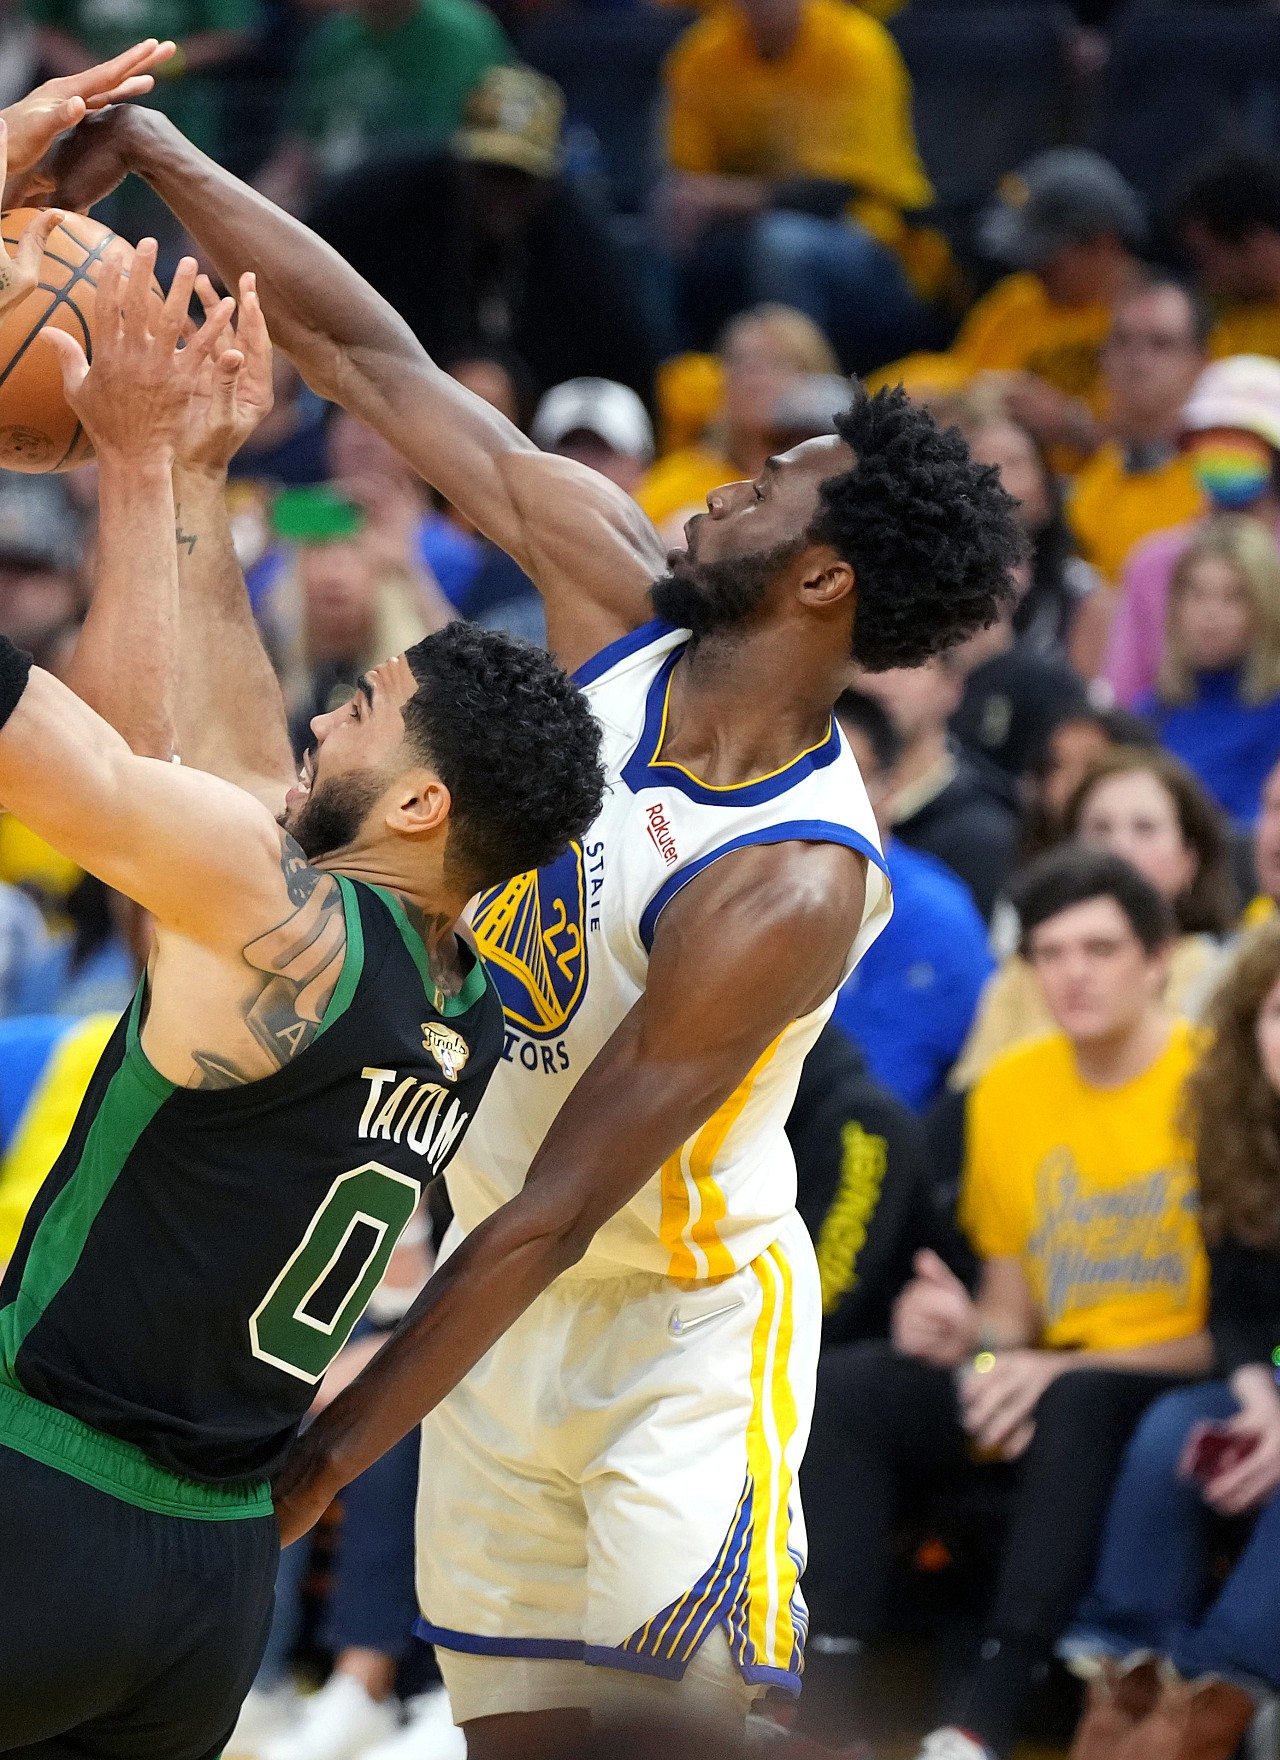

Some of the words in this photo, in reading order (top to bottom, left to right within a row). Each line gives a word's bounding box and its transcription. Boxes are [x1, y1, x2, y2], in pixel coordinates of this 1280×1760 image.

[645, 803, 678, 867] Rakuten
[542, 898, 581, 982] 22
[423, 1026, 468, 1055] Finals
[502, 1029, 570, 1074] IORS
[358, 1066, 469, 1176] TATUM
[248, 1160, 421, 1386] 0
